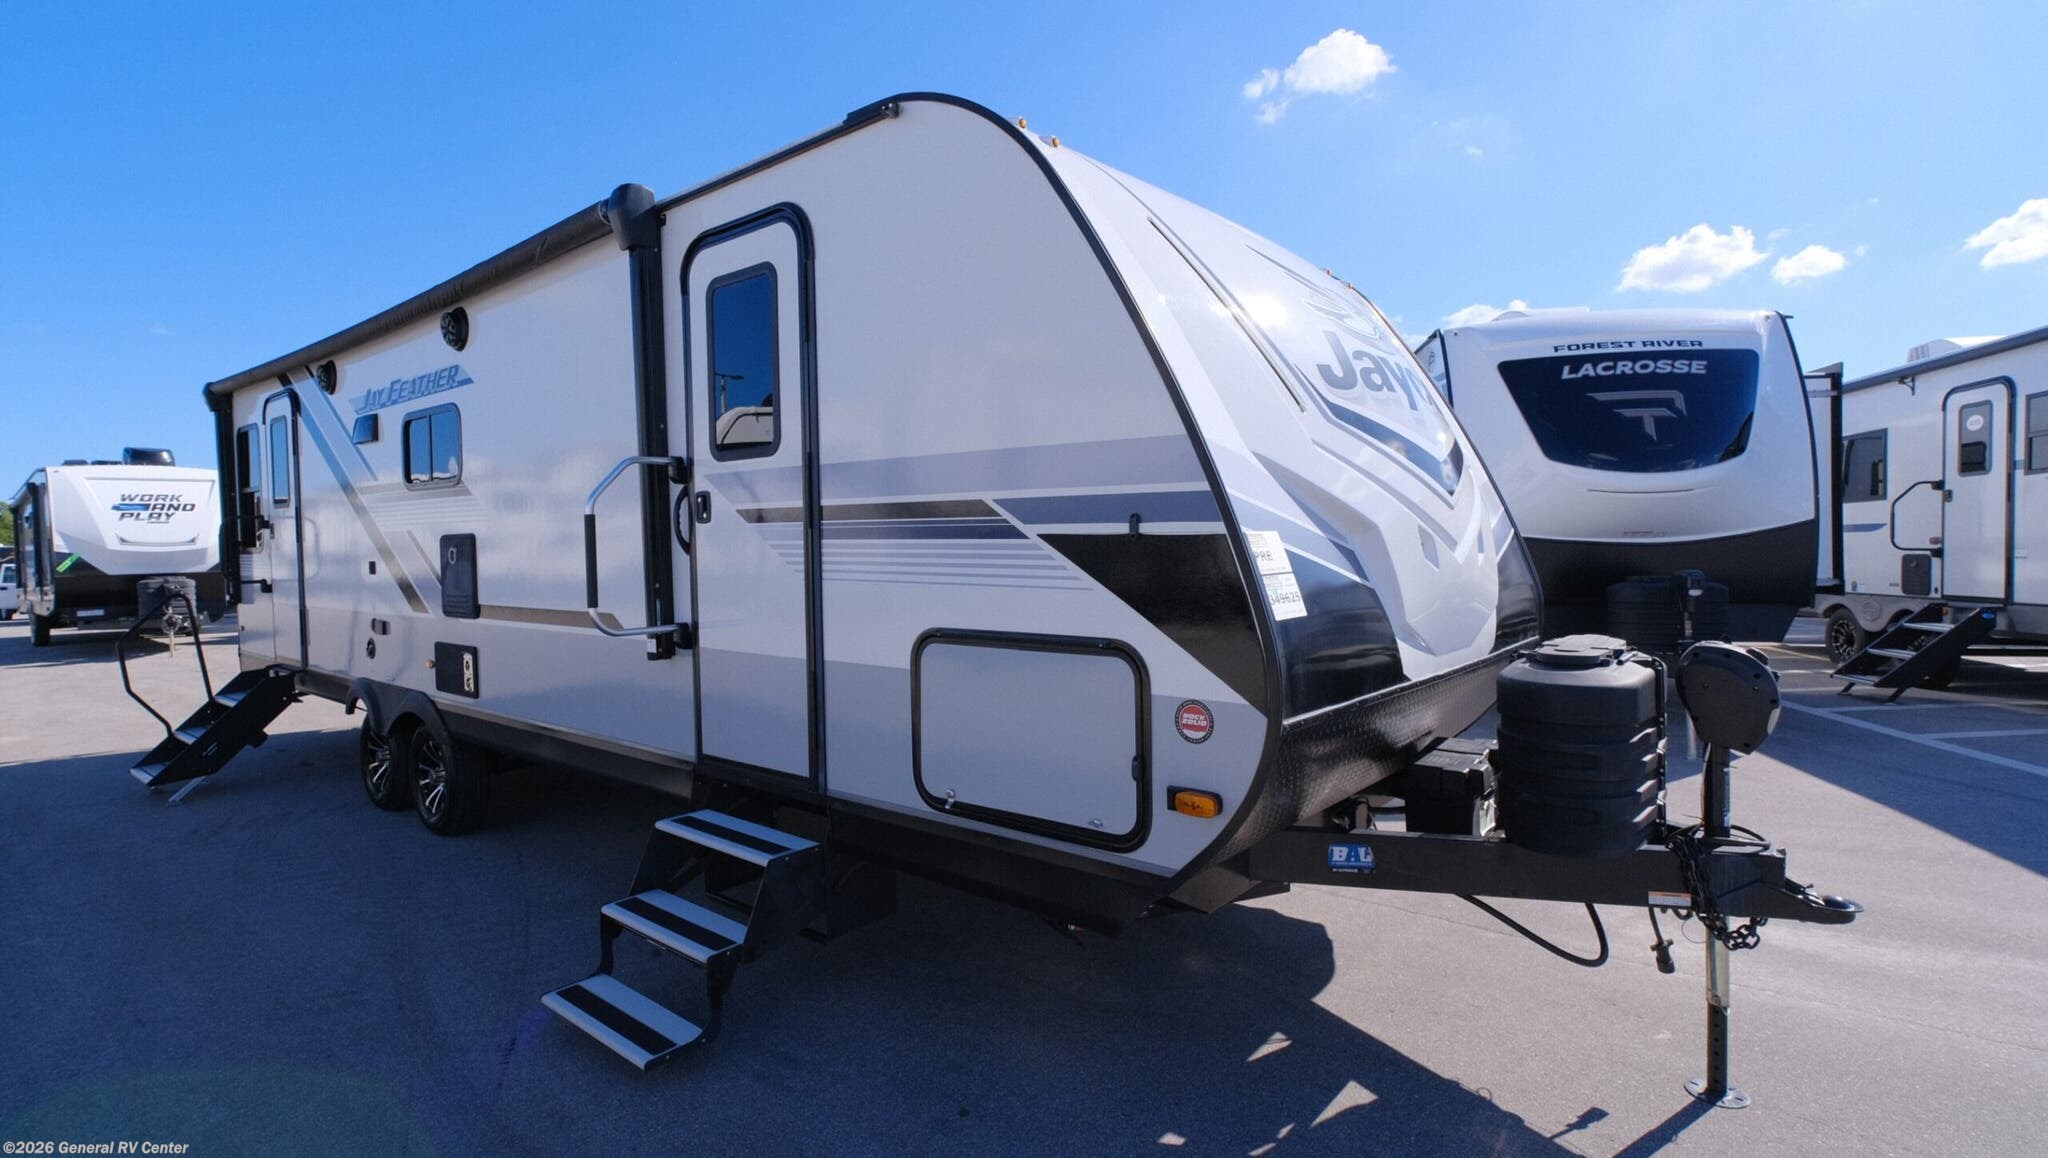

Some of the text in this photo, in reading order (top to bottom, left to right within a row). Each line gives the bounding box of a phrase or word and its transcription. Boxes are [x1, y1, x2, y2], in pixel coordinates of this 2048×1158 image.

[1553, 339, 1704, 352] FOREST RIVER
[1561, 359, 1708, 380] LACROSSE
[362, 364, 460, 410] JAY FEATHER
[120, 493, 183, 502] WORK
[150, 503, 196, 512] AND
[119, 512, 176, 521] PLAY
[1182, 713, 1206, 721] ROCK
[1181, 718, 1208, 727] SOLID
[1332, 846, 1373, 862] BAL
